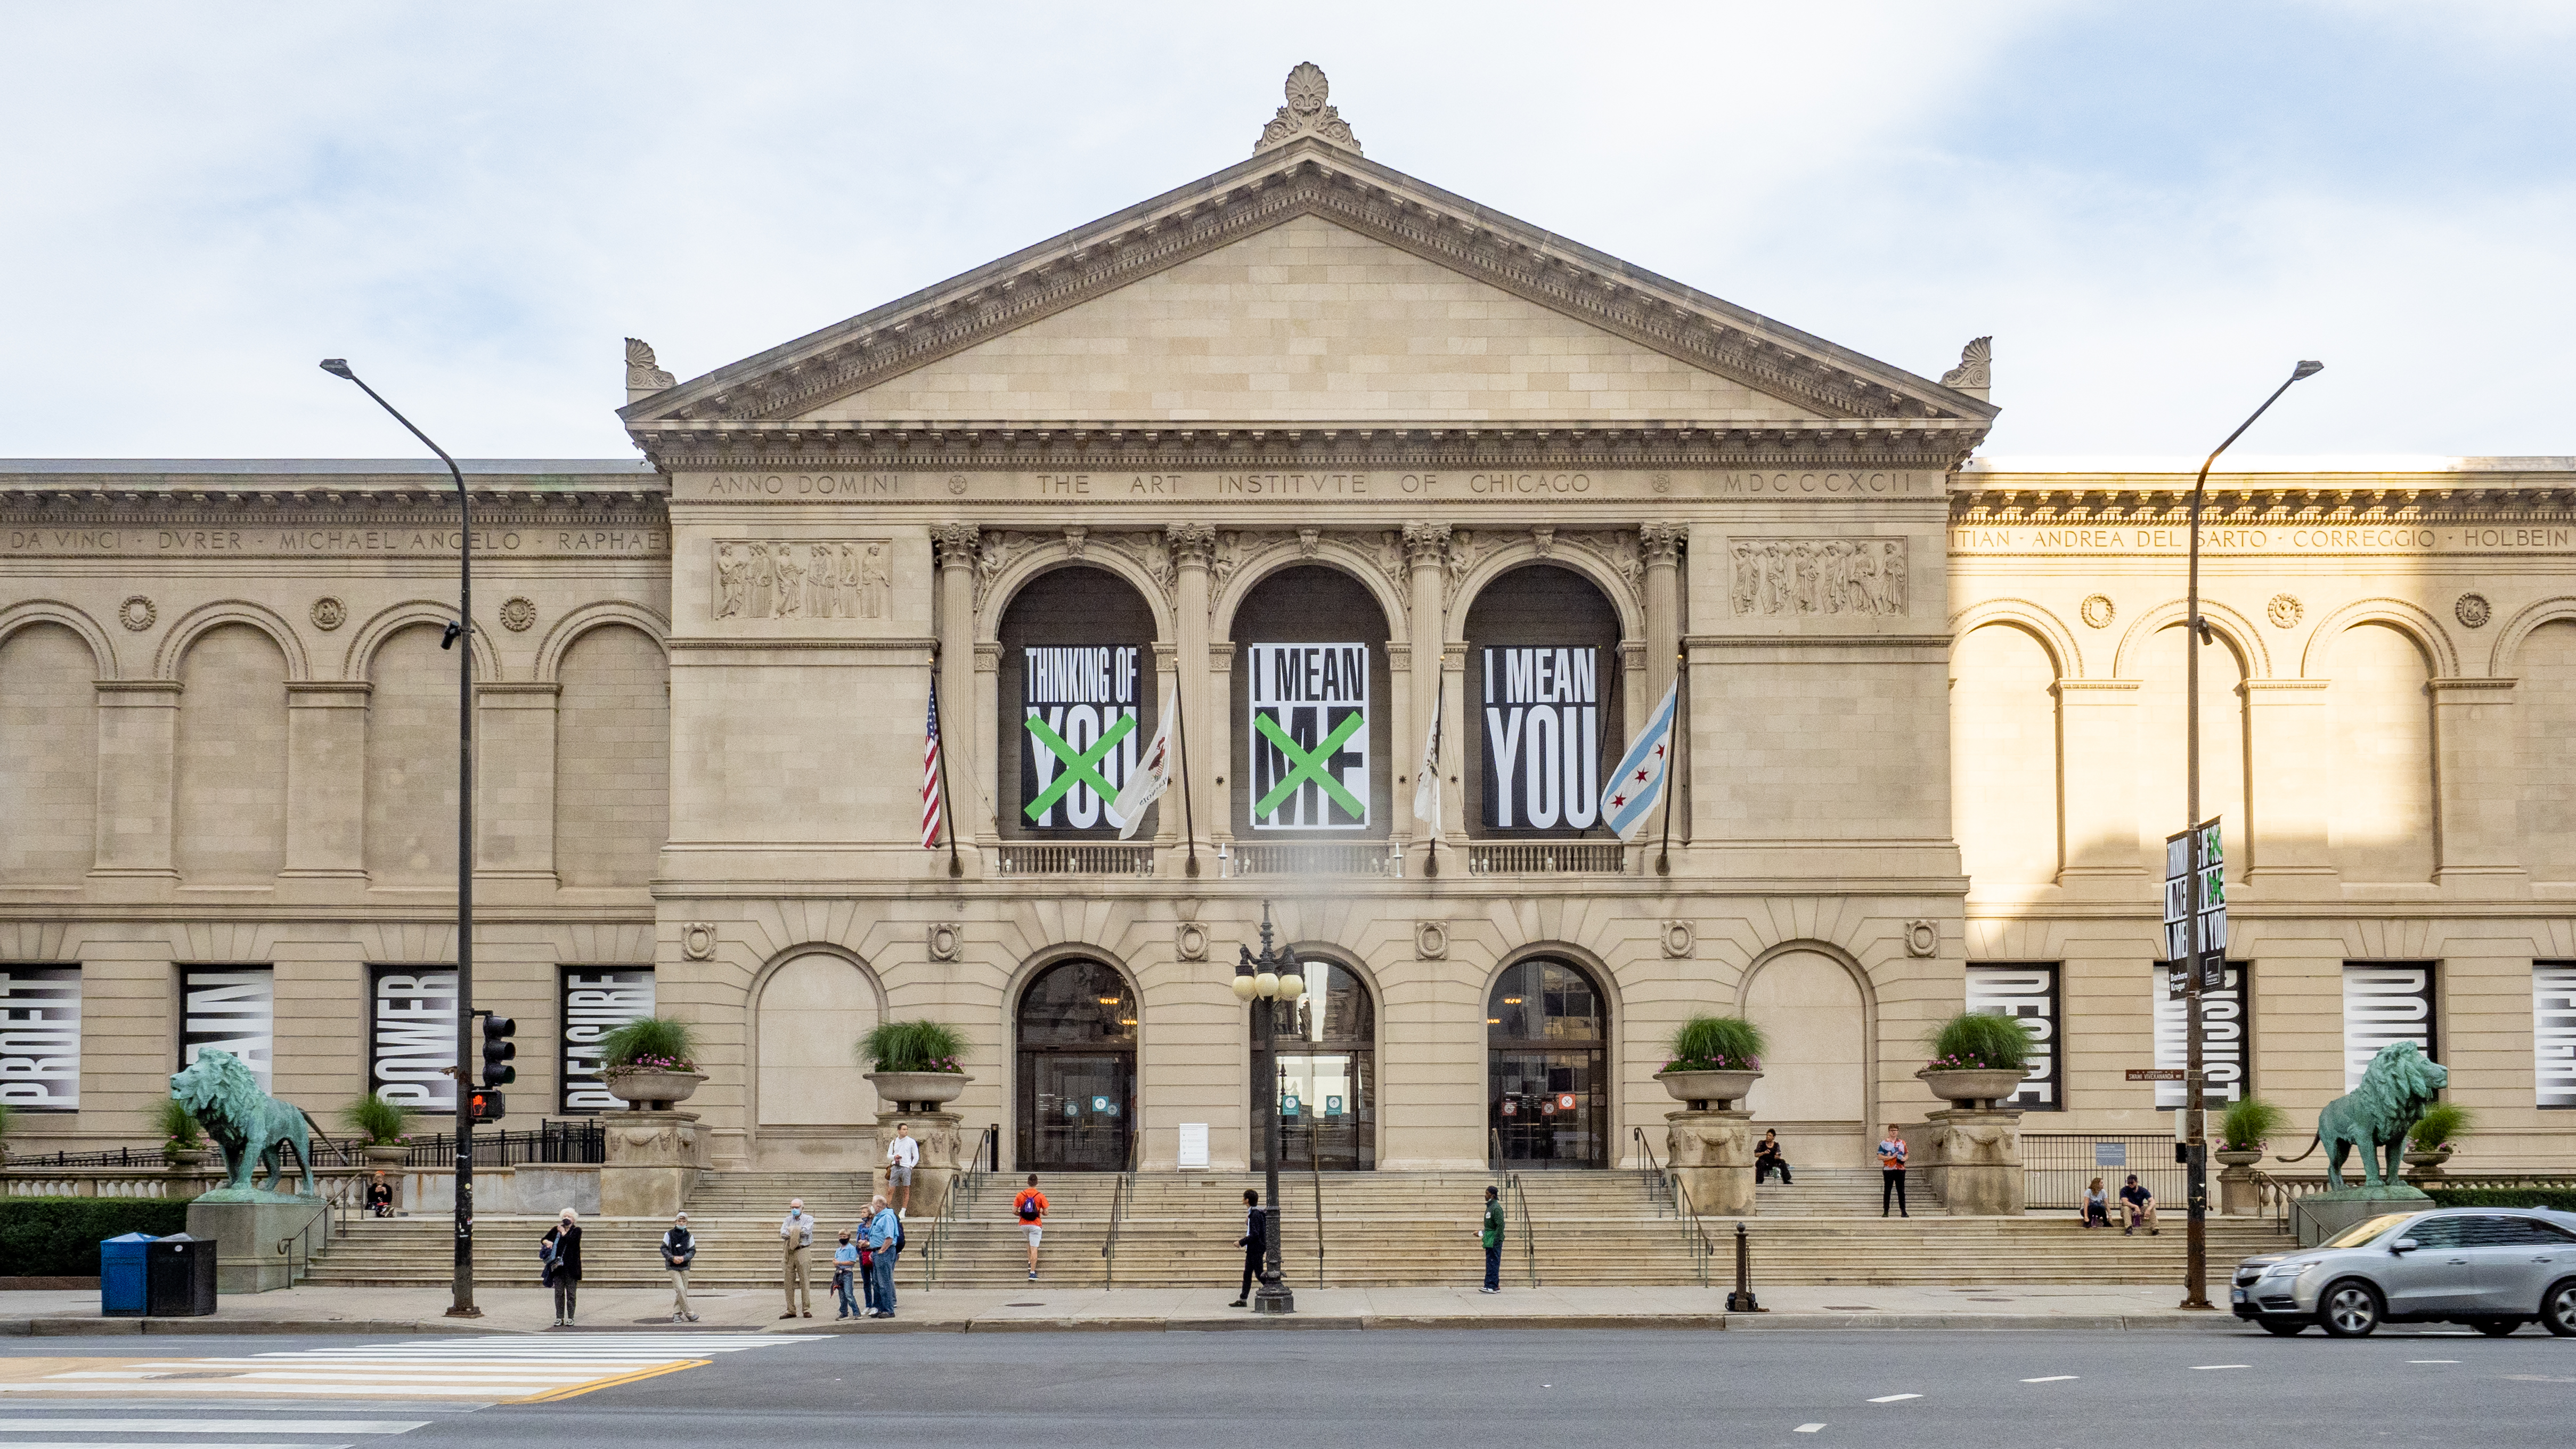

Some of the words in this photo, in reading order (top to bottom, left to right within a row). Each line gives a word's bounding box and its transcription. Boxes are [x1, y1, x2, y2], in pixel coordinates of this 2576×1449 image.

[708, 475, 783, 494] ANNO
[800, 475, 898, 494] DOMINI
[1037, 475, 1090, 494] THE
[1129, 475, 1182, 494] ART
[1218, 475, 1366, 493] INSTITVTE
[1401, 475, 1437, 493] OF
[1470, 474, 1590, 493] CHICAGO
[11, 532, 42, 549] DA
[53, 532, 121, 549] VINCI
[159, 532, 241, 549] DVRER
[279, 532, 397, 550] MICHAEL
[1951, 530, 2010, 547] ITIAN
[2032, 530, 2125, 547] ANDREA
[2137, 531, 2182, 547] DEL
[2197, 530, 2267, 548] SARTO
[2293, 530, 2435, 548] CORREGGIO
[2464, 529, 2568, 547] HOLBEIN
[1025, 647, 1110, 703] THINKING
[1115, 647, 1137, 703] OF
[1253, 648, 1261, 702] I
[1275, 648, 1364, 702] MEAN
[1485, 648, 1493, 703] I
[1506, 648, 1596, 703] MEAN
[1026, 704, 1137, 829] YOU
[1254, 706, 1365, 825] ME
[1486, 704, 1597, 829] YOU
[2208, 910, 2227, 951] YOU
[0, 973, 80, 1109] PROFIT
[186, 973, 273, 1072] AIN
[374, 975, 458, 1106] POWER
